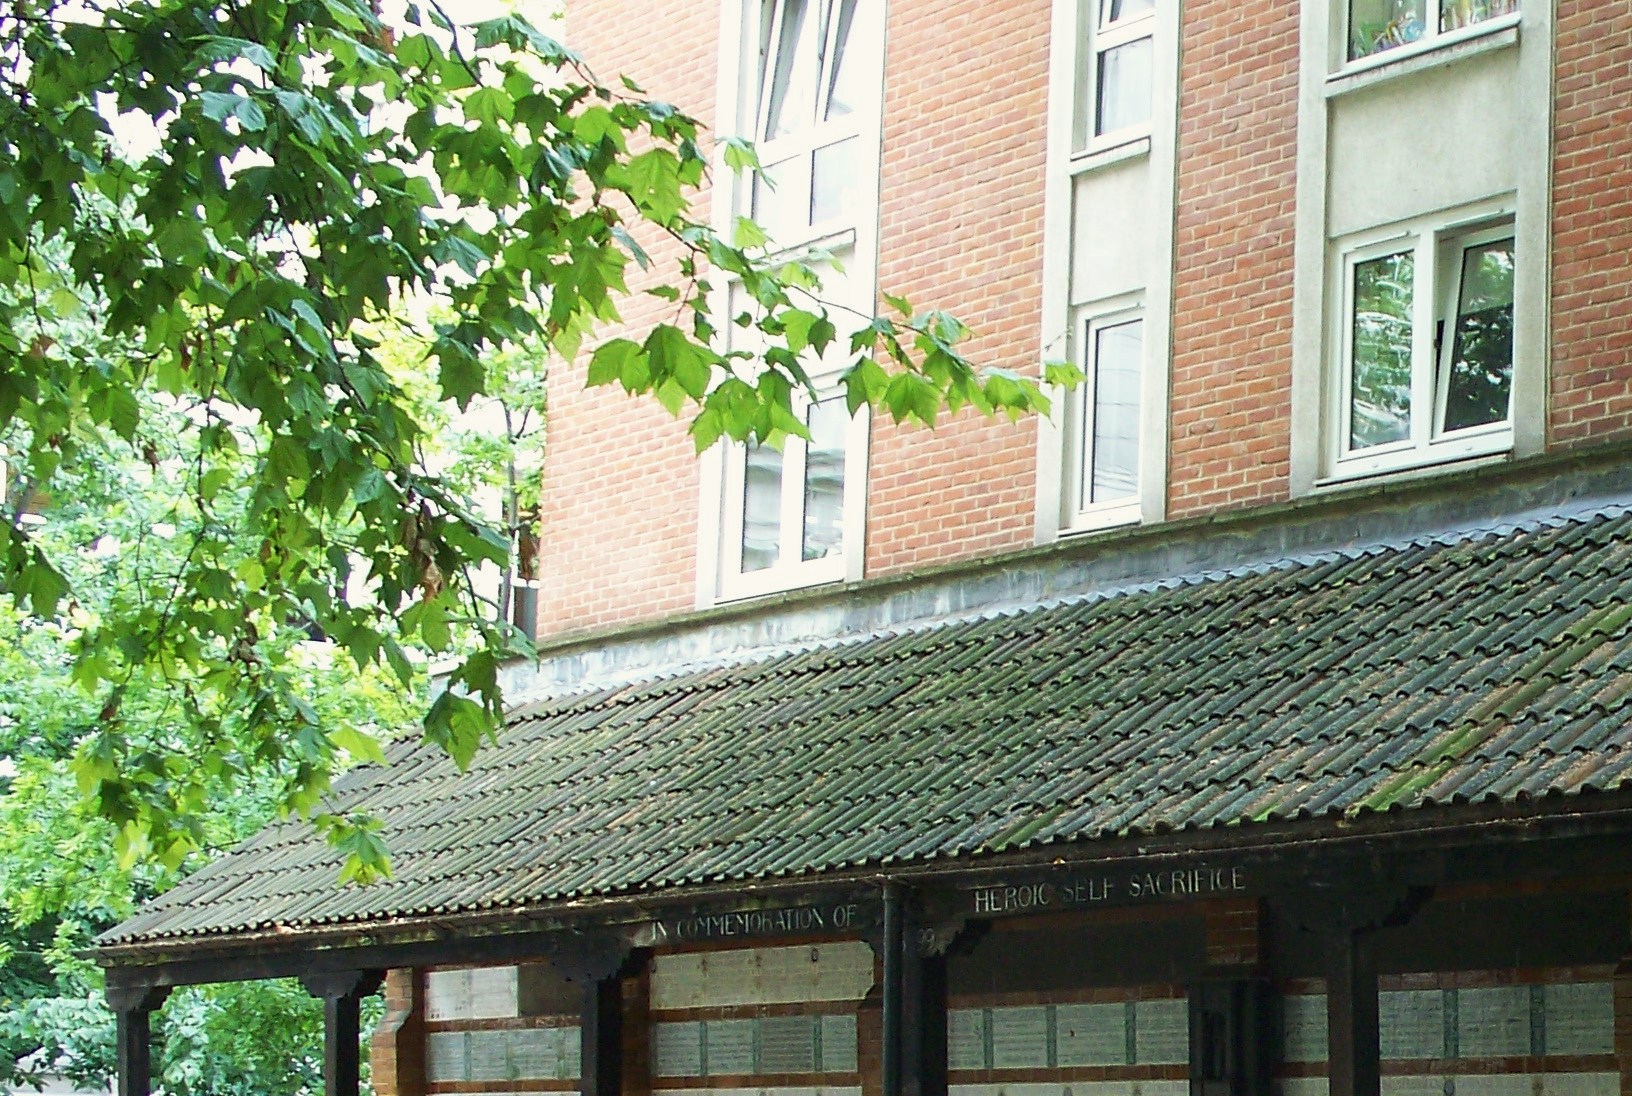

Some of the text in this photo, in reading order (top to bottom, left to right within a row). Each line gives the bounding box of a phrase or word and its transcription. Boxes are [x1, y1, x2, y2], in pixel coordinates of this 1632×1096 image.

[974, 865, 1246, 913] HEROIC SELF SACRIFICE
[651, 904, 858, 941] IN COMMEMORATION OF
